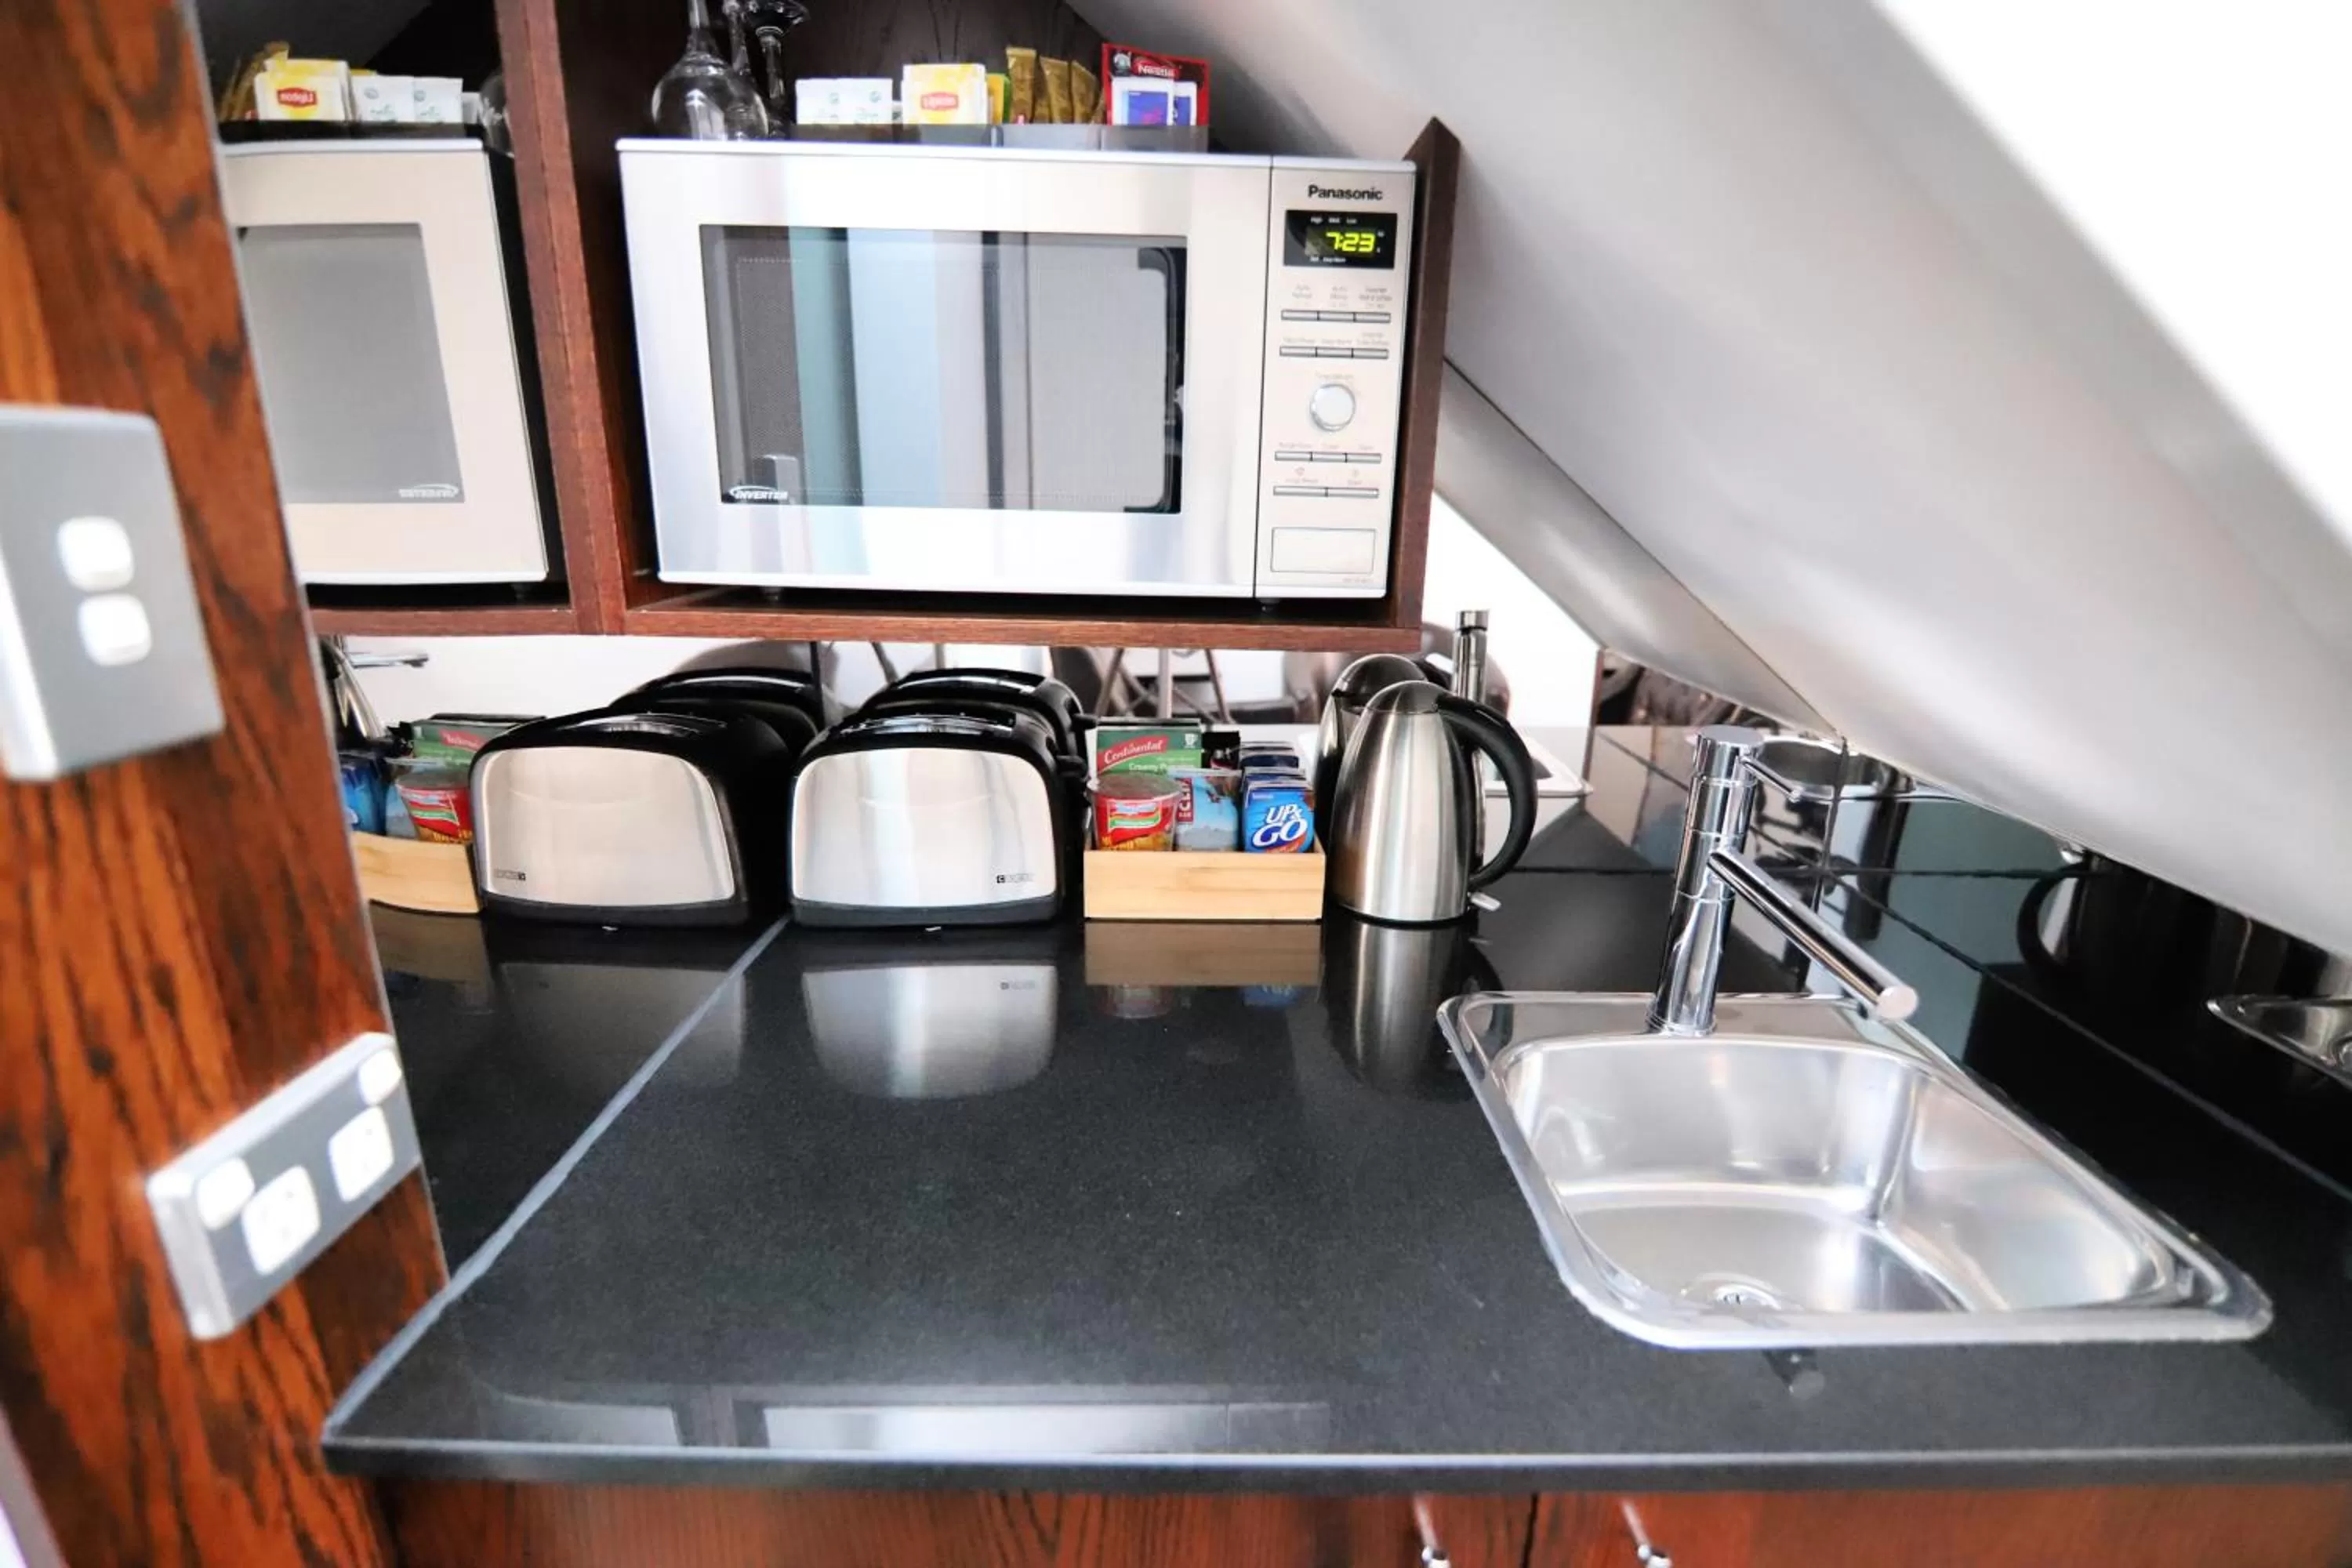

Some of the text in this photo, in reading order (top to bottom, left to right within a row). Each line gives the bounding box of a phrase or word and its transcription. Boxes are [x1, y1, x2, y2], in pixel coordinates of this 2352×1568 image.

[1308, 184, 1383, 201] Panasonic
[1325, 230, 1376, 252] 7:23
[1104, 739, 1163, 764] Continental
[1252, 818, 1308, 848] GO
